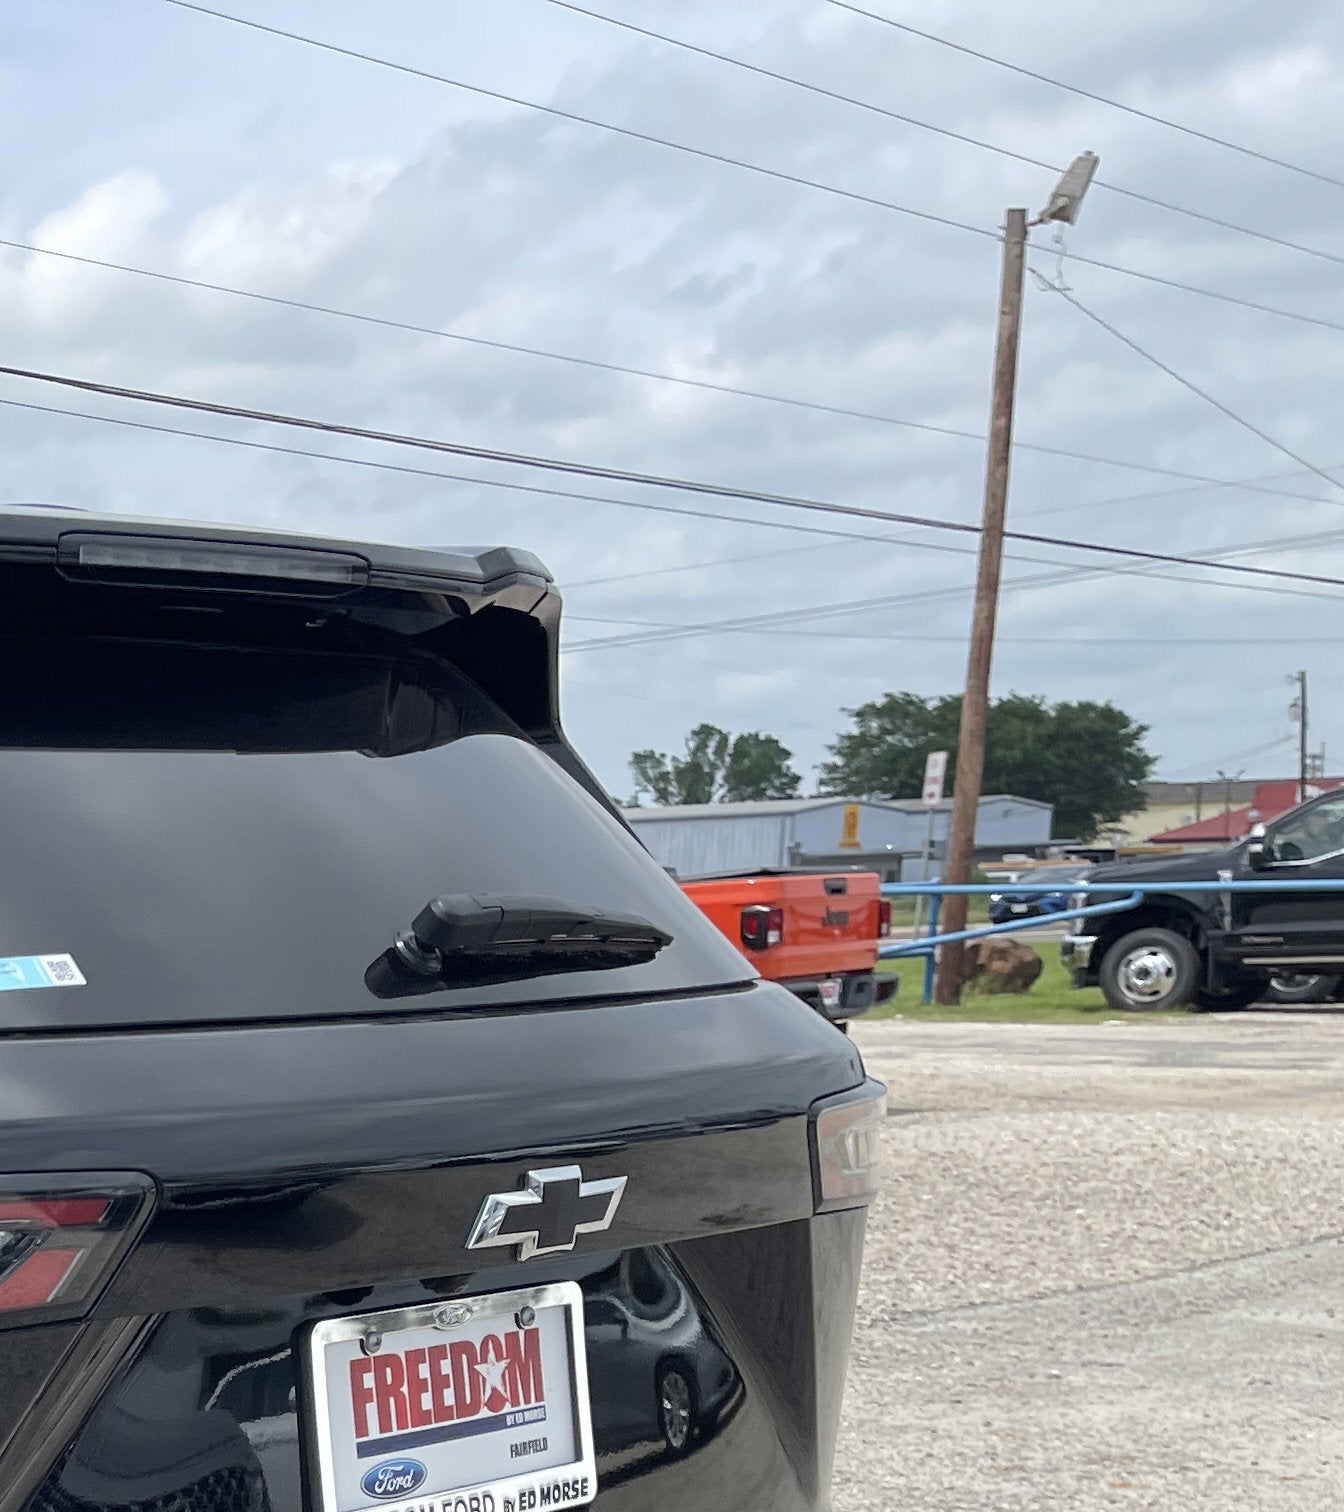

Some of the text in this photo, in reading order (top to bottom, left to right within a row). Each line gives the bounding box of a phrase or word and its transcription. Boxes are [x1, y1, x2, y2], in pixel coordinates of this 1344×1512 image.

[349, 1327, 545, 1439] FREEDOM
[510, 1437, 548, 1459] FAIRFIELD
[374, 1465, 415, 1494] Ford
[518, 1490, 536, 1511] ED
[539, 1478, 589, 1508] MORSE
